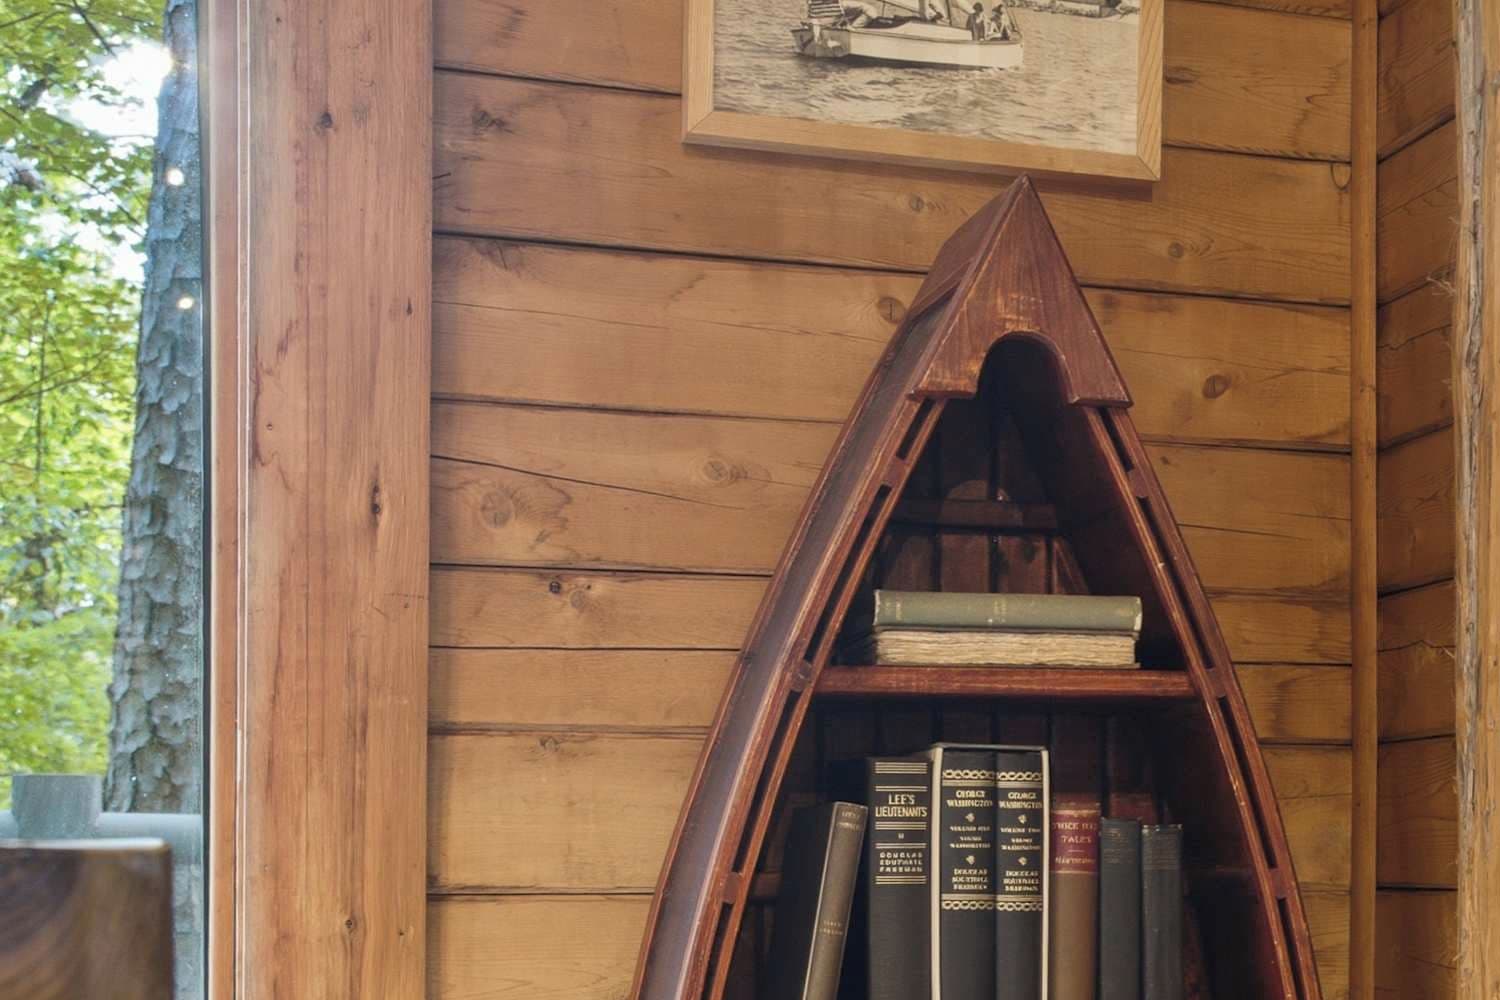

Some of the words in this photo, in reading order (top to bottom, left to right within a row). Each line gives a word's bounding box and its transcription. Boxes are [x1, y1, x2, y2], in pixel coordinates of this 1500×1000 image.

[956, 790, 986, 798] GEORGE
[889, 795, 915, 804] LEE'S
[946, 800, 993, 808] WASHINGTON
[999, 801, 1042, 809] WASHINGTON
[875, 806, 927, 817] LIEUTENANTS
